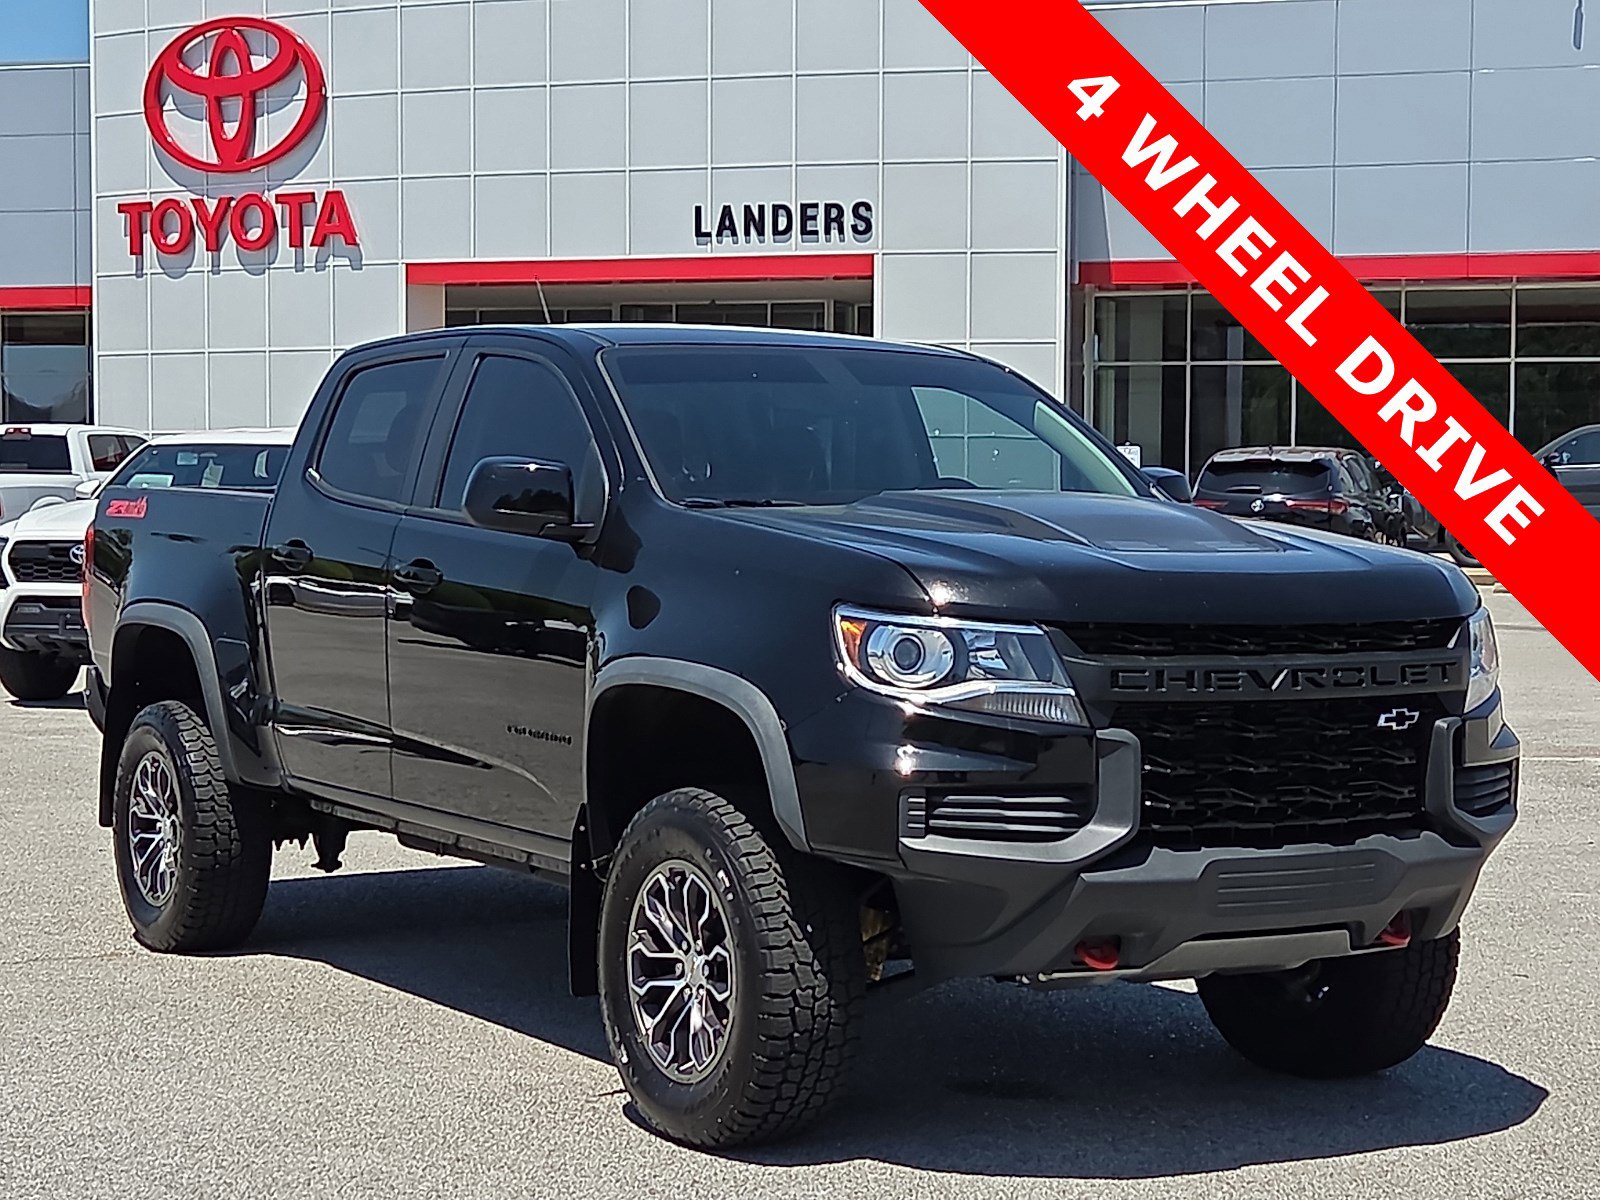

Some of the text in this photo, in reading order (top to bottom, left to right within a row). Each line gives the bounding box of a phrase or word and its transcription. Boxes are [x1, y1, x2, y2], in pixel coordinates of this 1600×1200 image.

[118, 191, 360, 256] TOYOTA
[694, 201, 874, 238] LANDERS
[1110, 662, 1458, 692] CHEVROLET
